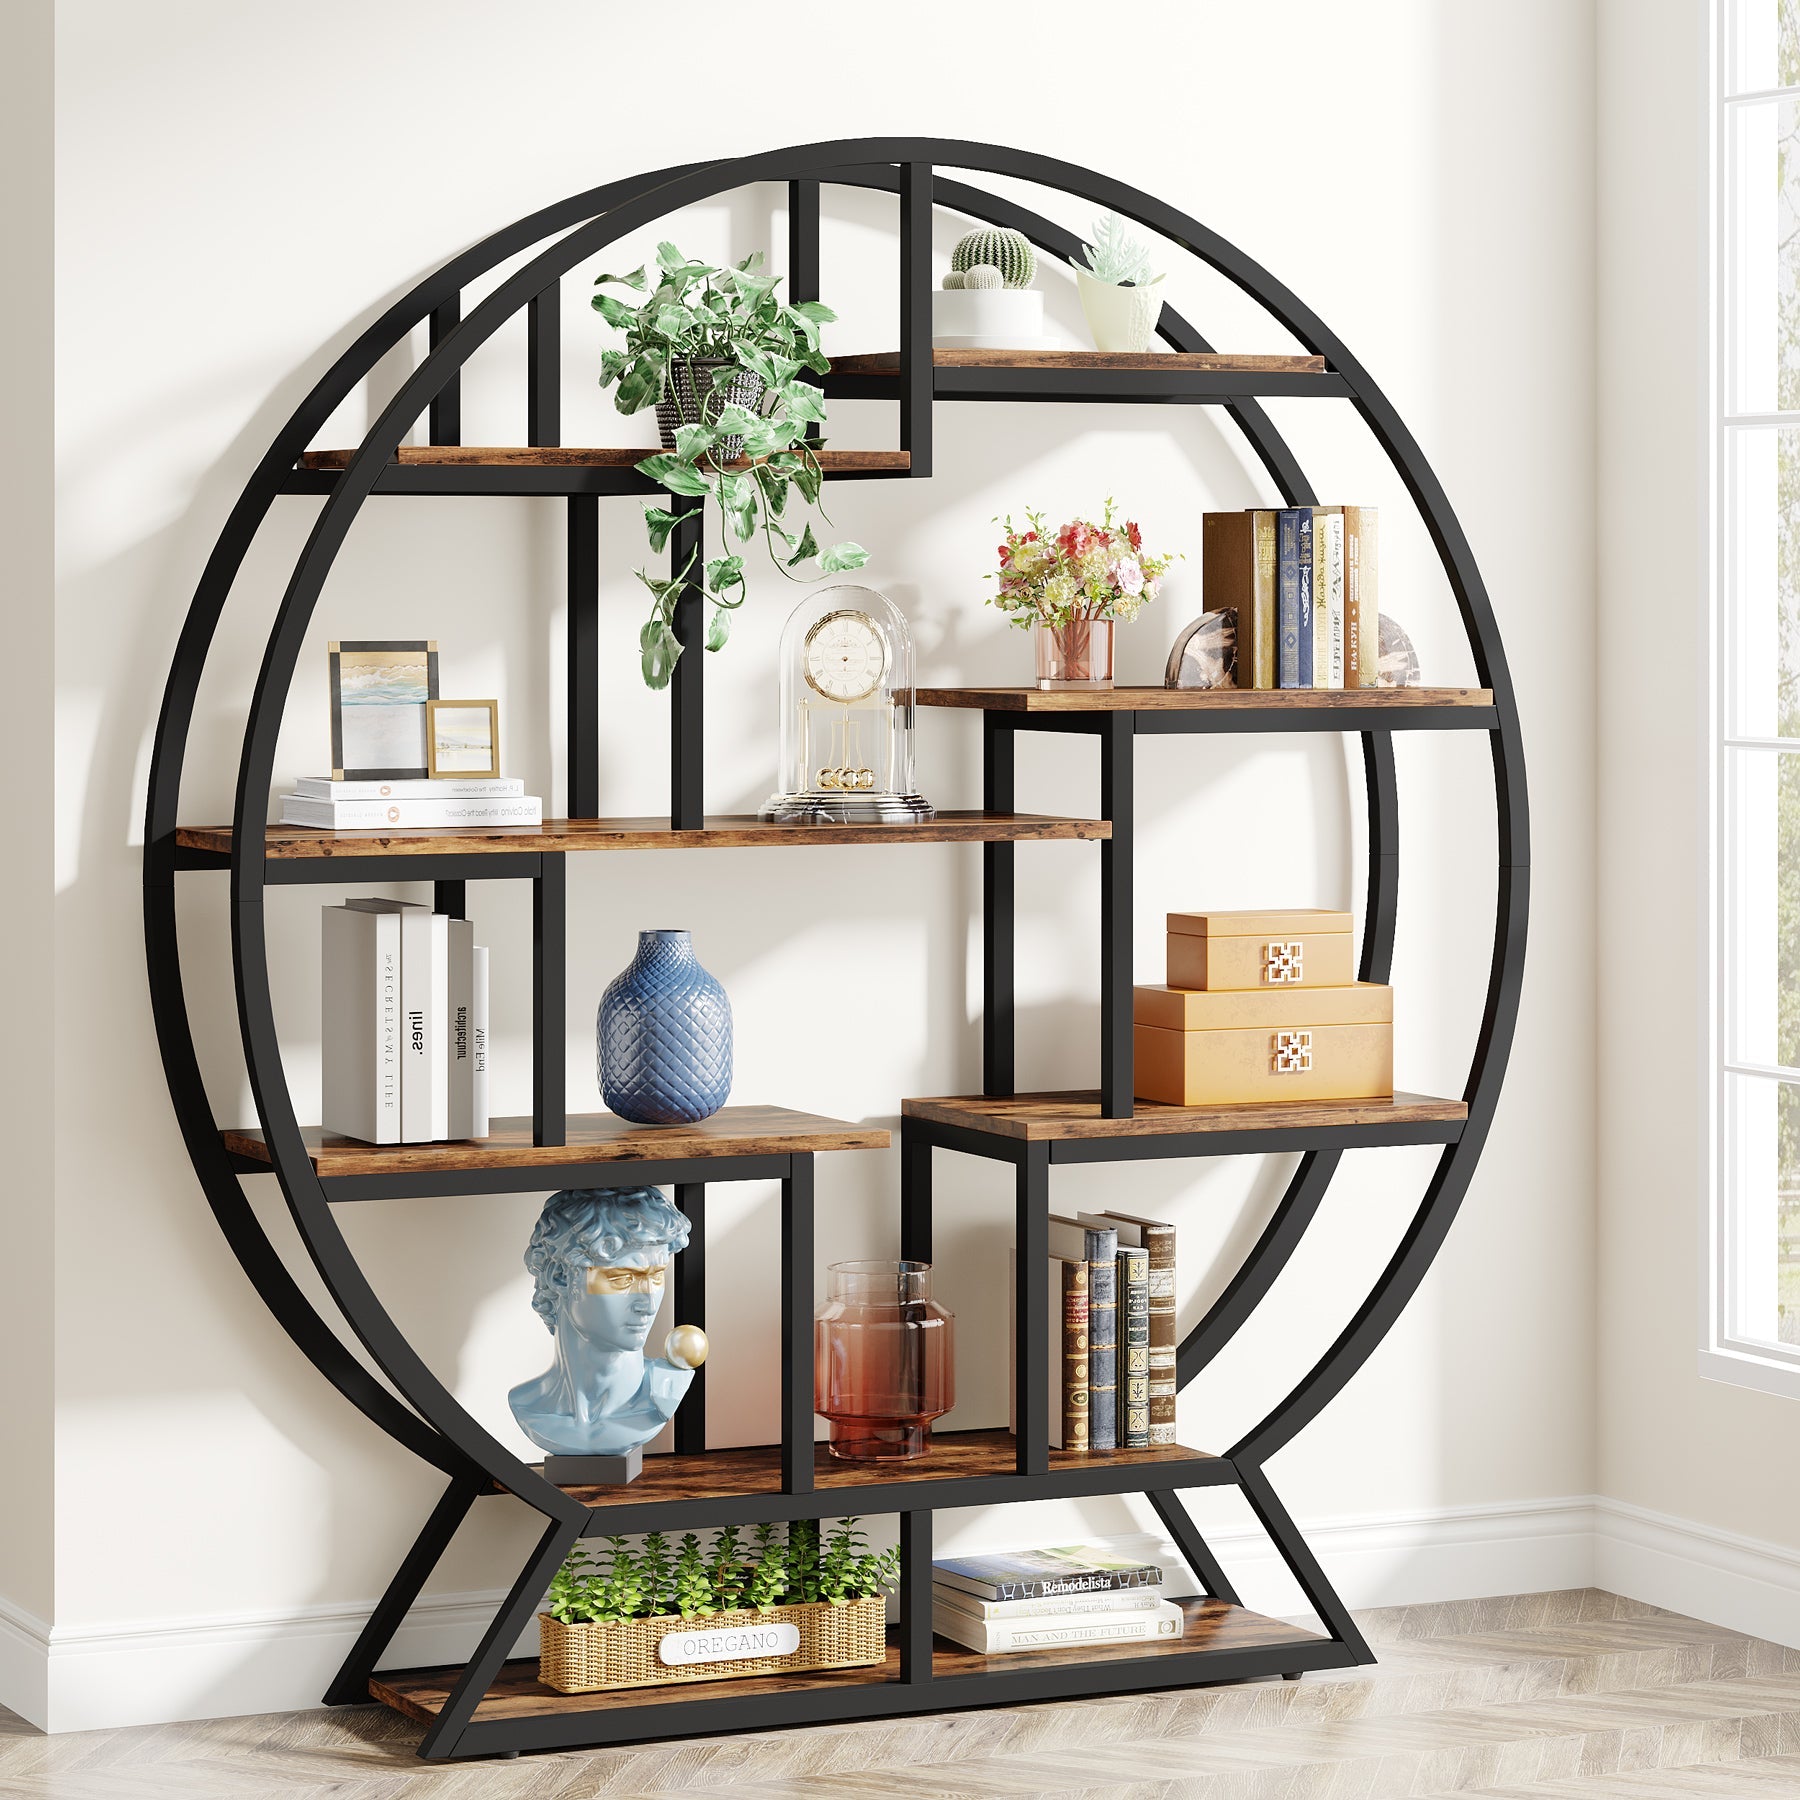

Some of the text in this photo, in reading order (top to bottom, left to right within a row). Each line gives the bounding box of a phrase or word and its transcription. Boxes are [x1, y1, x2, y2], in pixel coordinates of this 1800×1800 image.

[1317, 525, 1327, 564] жизни
[1316, 566, 1327, 609] Жажда
[1043, 1576, 1112, 1594] Remodelista
[683, 1631, 779, 1656] OREGANO
[1011, 1634, 1039, 1645] MAN
[1043, 1631, 1068, 1642] AND
[1071, 1629, 1096, 1639] THE
[1100, 1625, 1146, 1637] FUTURE
